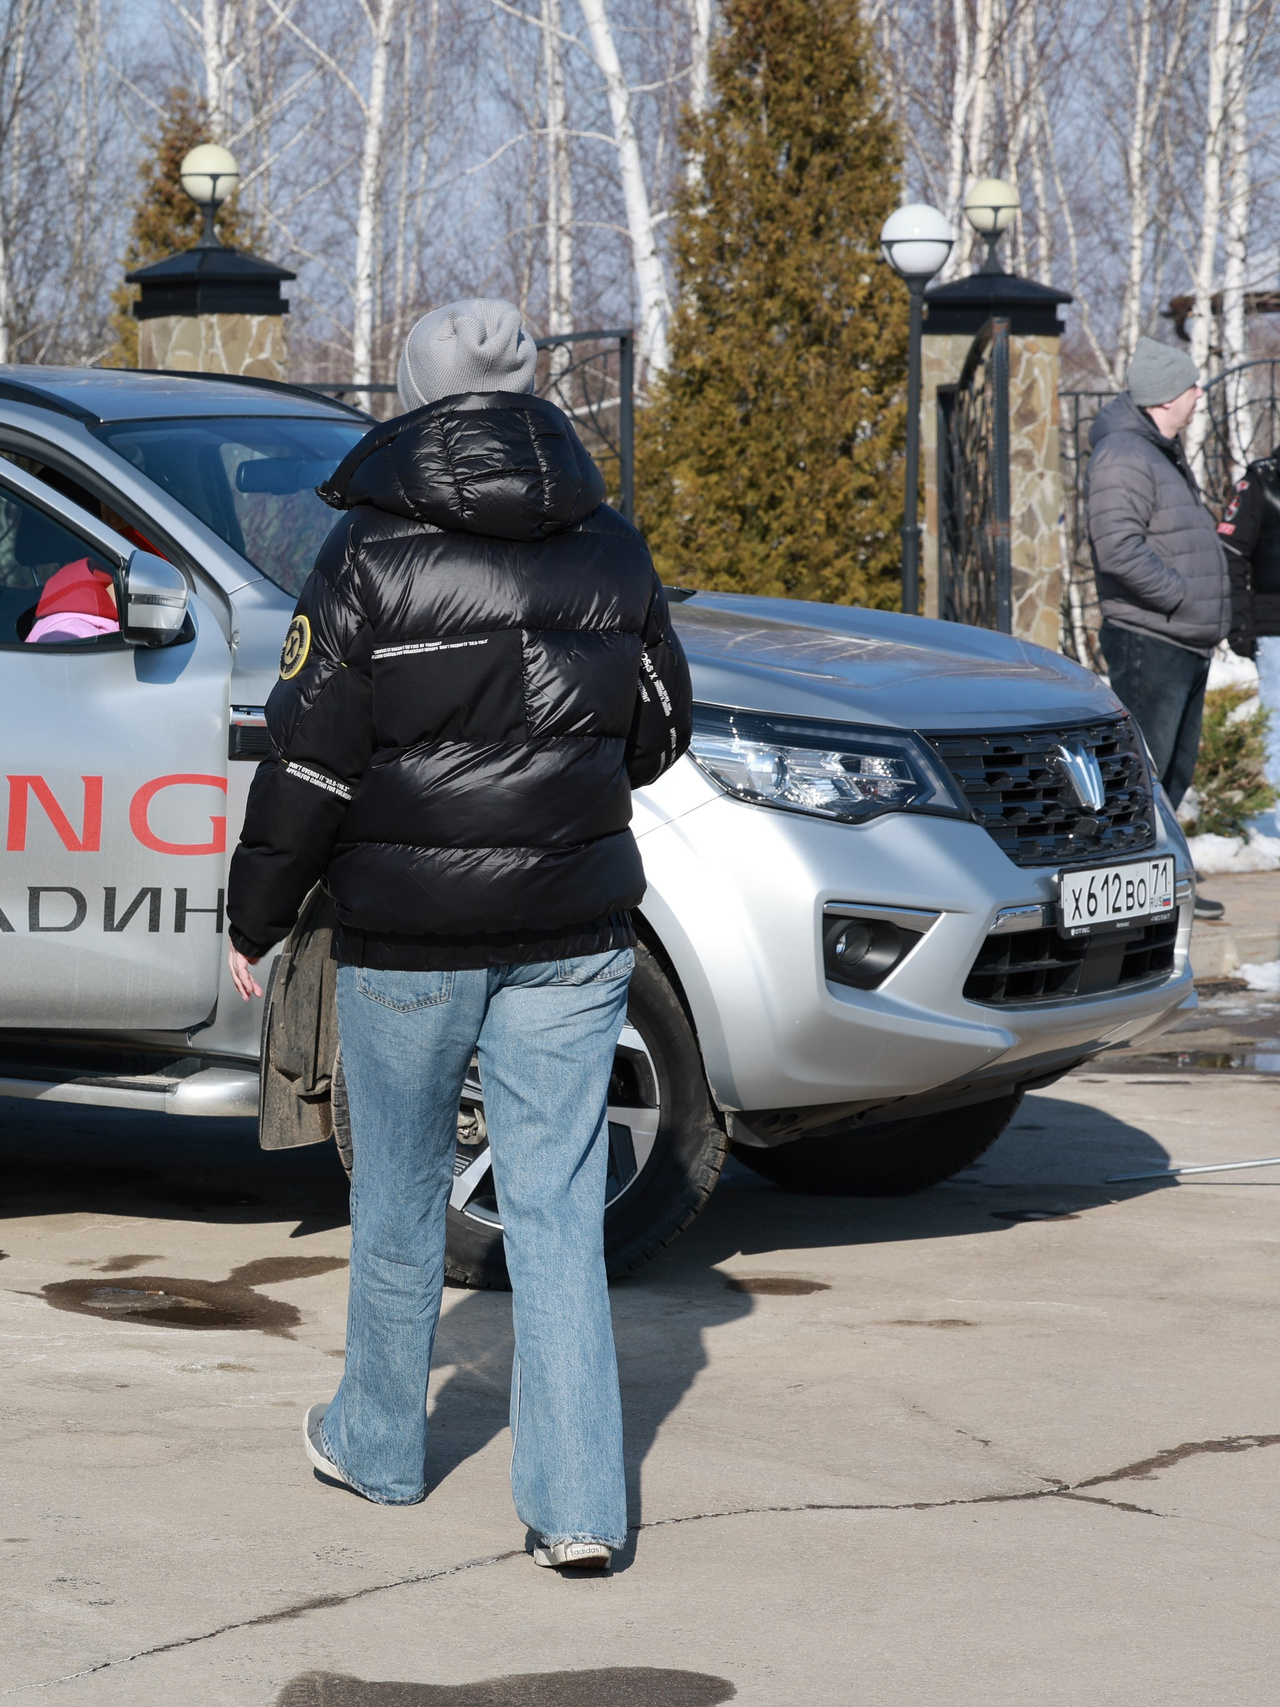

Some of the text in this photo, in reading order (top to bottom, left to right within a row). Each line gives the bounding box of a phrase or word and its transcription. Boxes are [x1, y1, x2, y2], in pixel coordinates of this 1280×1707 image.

[1152, 862, 1167, 895] 71
[1150, 895, 1162, 909] RUS
[574, 1547, 600, 1555] adidas
